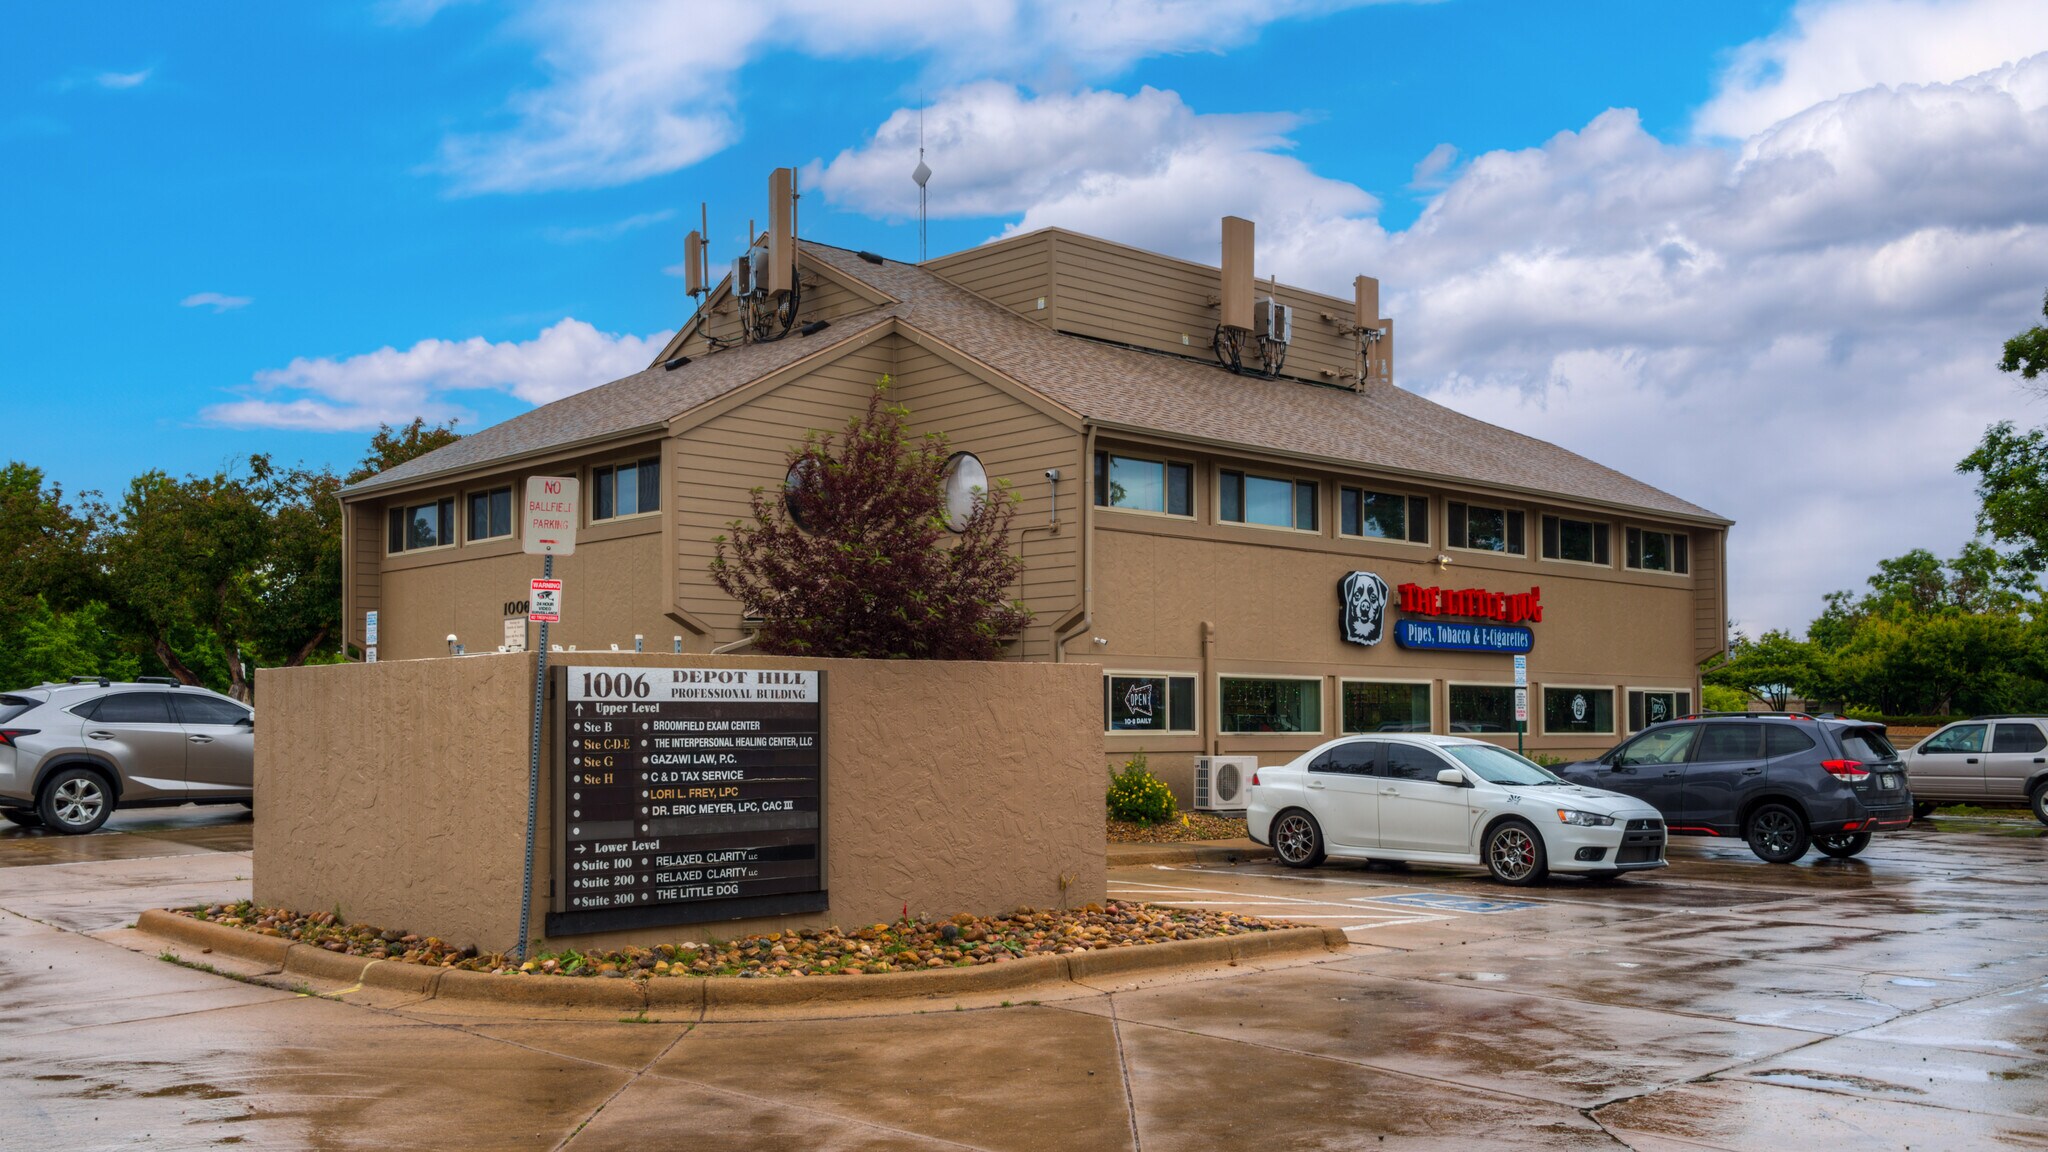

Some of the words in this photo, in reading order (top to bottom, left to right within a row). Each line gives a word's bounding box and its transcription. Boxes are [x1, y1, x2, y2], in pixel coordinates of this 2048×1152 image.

[544, 481, 561, 494] NO
[529, 501, 575, 513] BALLFIELD
[533, 518, 569, 530] PARKING
[533, 582, 560, 590] WARNING
[504, 600, 530, 616] 1006
[1398, 583, 1440, 616] THE
[1441, 589, 1506, 620] LITTLE
[1505, 584, 1543, 623] DOG
[1408, 624, 1434, 644] Pipes,
[1438, 626, 1471, 644] Tobacco
[1473, 627, 1480, 644] &
[1482, 628, 1529, 648] E-Cigarettes
[672, 670, 748, 684] DEPOT
[757, 672, 806, 685] HILL
[583, 672, 650, 698] 1006
[671, 688, 752, 699] PROFESSIONAL
[756, 689, 806, 700] BUILDING
[1130, 693, 1147, 706] OPEN
[595, 702, 628, 716] Upper
[632, 702, 660, 713] Level
[584, 721, 601, 732] Ste
[604, 721, 613, 732] B
[653, 721, 705, 731] BROOMFIELD
[706, 721, 729, 731] EXAM
[731, 721, 760, 731] CENTER
[1136, 717, 1152, 725] DAILY
[584, 739, 601, 750] Ste
[604, 738, 631, 750] C-D-E
[654, 738, 670, 748] THE
[672, 738, 734, 748] INTERPERSONAL
[736, 737, 767, 747] HEALING
[769, 737, 798, 748] CENTER,
[800, 737, 813, 746] LLC
[584, 757, 601, 767] Ste
[604, 756, 613, 767] G
[651, 755, 691, 764] GAZAWI
[694, 754, 717, 765] LAW,
[719, 754, 737, 763] P.C.
[584, 774, 601, 785] Ste
[604, 773, 613, 784] H
[651, 772, 659, 782] C
[661, 772, 668, 782] &
[671, 772, 678, 782] D
[681, 771, 700, 781] TAX
[702, 770, 744, 780] SERVICE
[650, 789, 675, 800] LORI
[677, 789, 686, 799] L.
[689, 788, 716, 799] FREY,
[719, 787, 738, 797] LPC
[652, 805, 670, 816] DR.
[672, 804, 696, 815] ERIC
[699, 803, 736, 815] MEYER,
[738, 802, 760, 813] LPC,
[762, 800, 782, 811] CAC
[783, 800, 794, 810] III
[595, 842, 628, 853] Lower
[632, 840, 660, 851] Level
[581, 860, 609, 871] Suite
[613, 857, 632, 869] 100
[656, 854, 702, 866] RELAXED
[706, 851, 747, 863] CLARITY
[581, 877, 609, 888] Suite
[613, 874, 635, 886] 200
[656, 870, 702, 883] RELAXED
[706, 867, 747, 879] CLARITY
[656, 889, 677, 900] THE
[680, 886, 714, 898] LITTLE
[716, 884, 739, 895] DOG
[581, 895, 610, 907] Suite
[613, 893, 635, 904] 300
